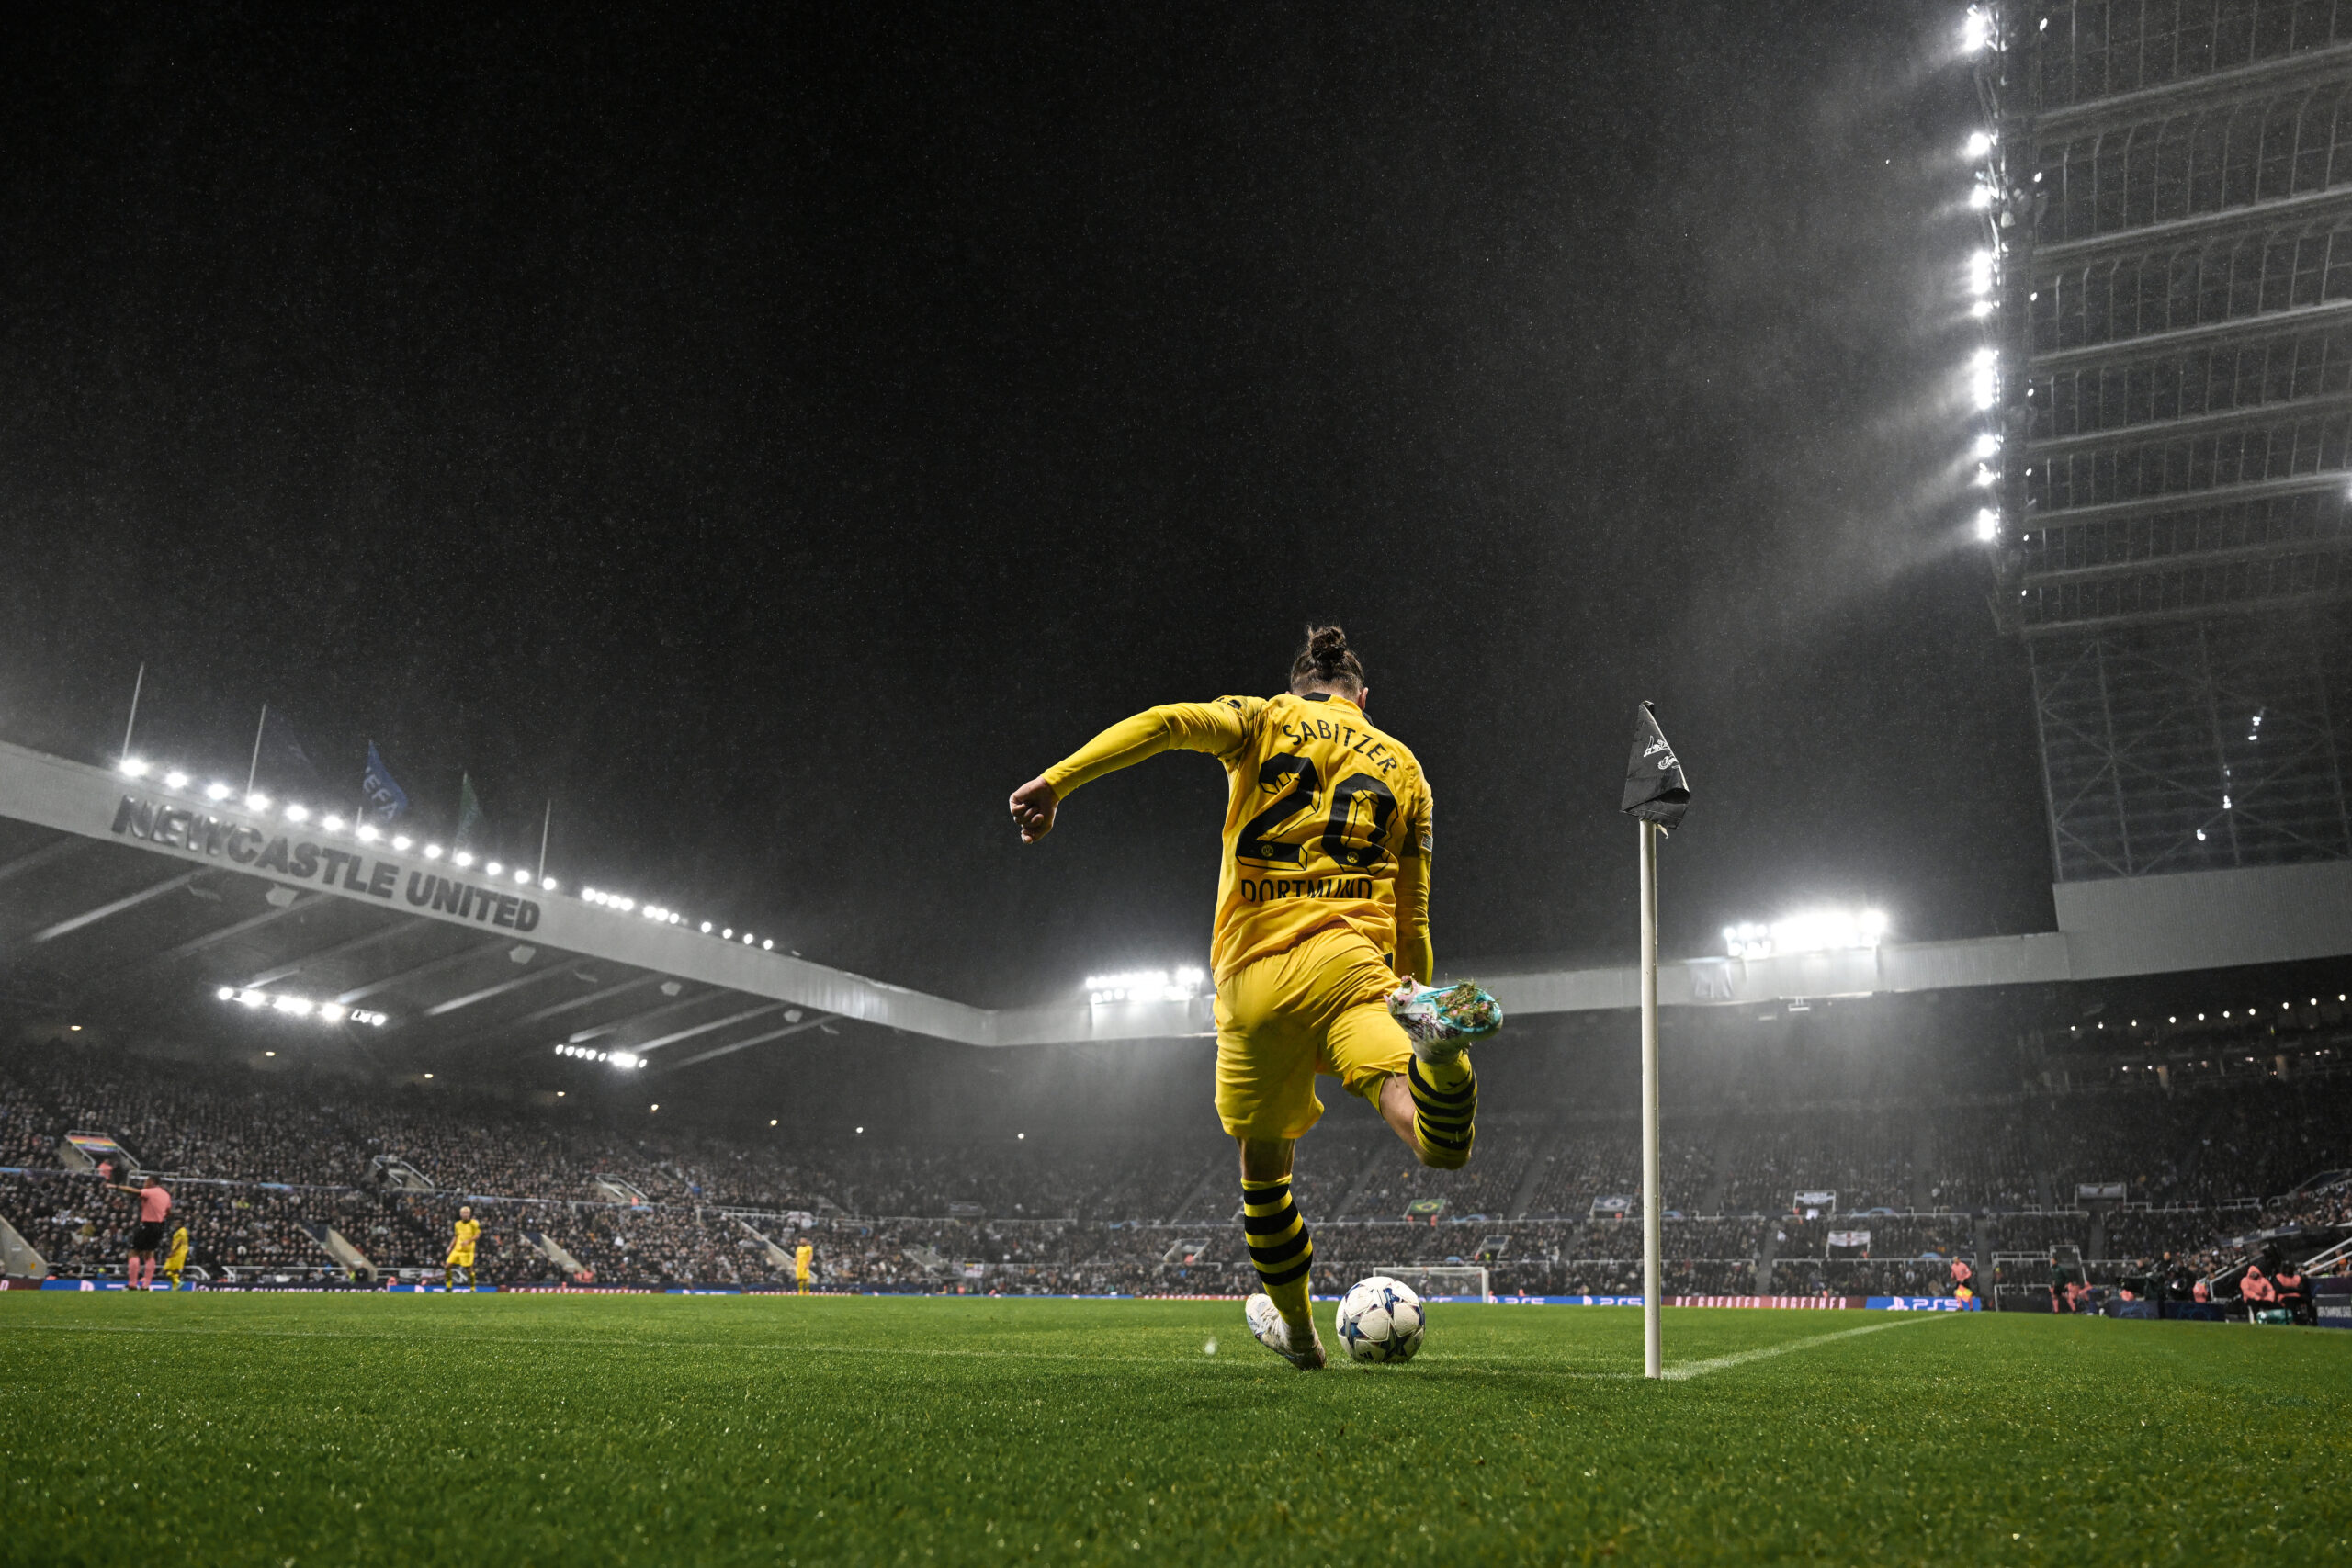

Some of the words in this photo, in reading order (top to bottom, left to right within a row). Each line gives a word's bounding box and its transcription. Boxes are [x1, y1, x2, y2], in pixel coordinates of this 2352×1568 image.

[1283, 719, 1397, 774] SABITZER
[363, 766, 398, 820] EFA
[1235, 751, 1400, 876] 20
[111, 794, 401, 899] NEWCASTLE
[406, 870, 542, 932] UNITED
[1241, 878, 1373, 902] DORTMUND
[1912, 1298, 1960, 1312] PS5
